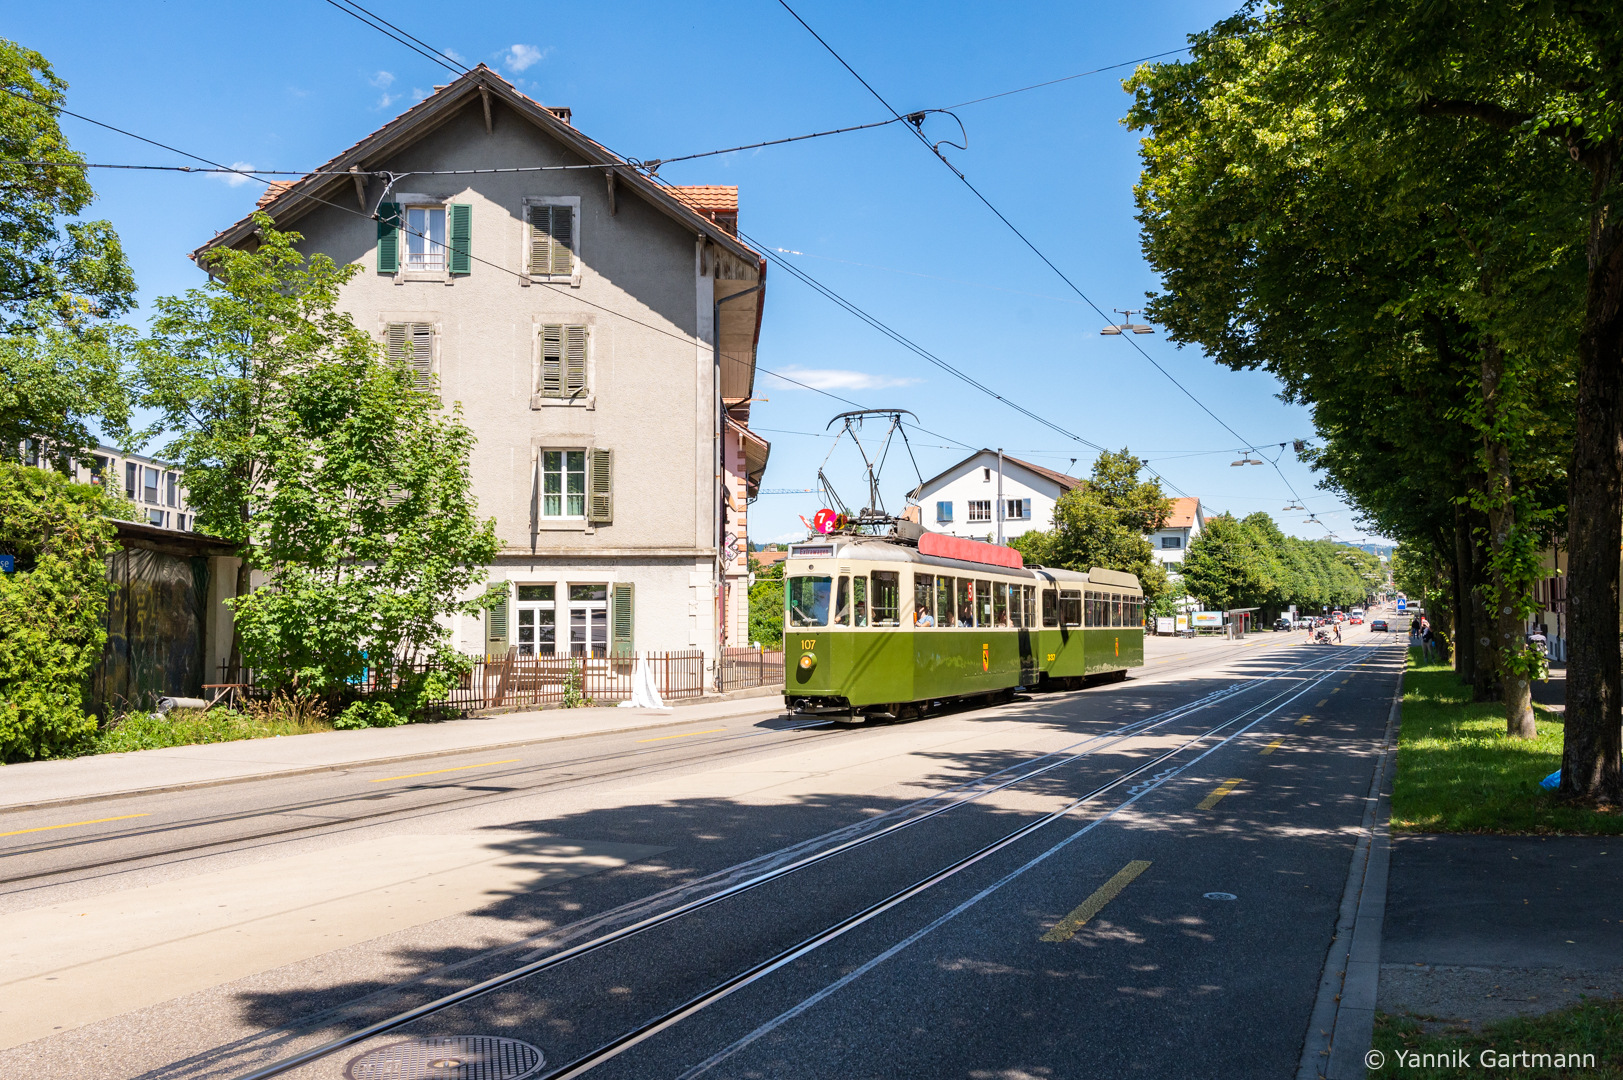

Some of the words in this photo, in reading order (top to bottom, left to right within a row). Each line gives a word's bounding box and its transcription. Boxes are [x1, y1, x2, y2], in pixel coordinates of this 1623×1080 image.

[817, 512, 826, 524] 7
[825, 520, 833, 532] 8
[799, 548, 829, 556] Extrawagen
[801, 639, 816, 650] 107
